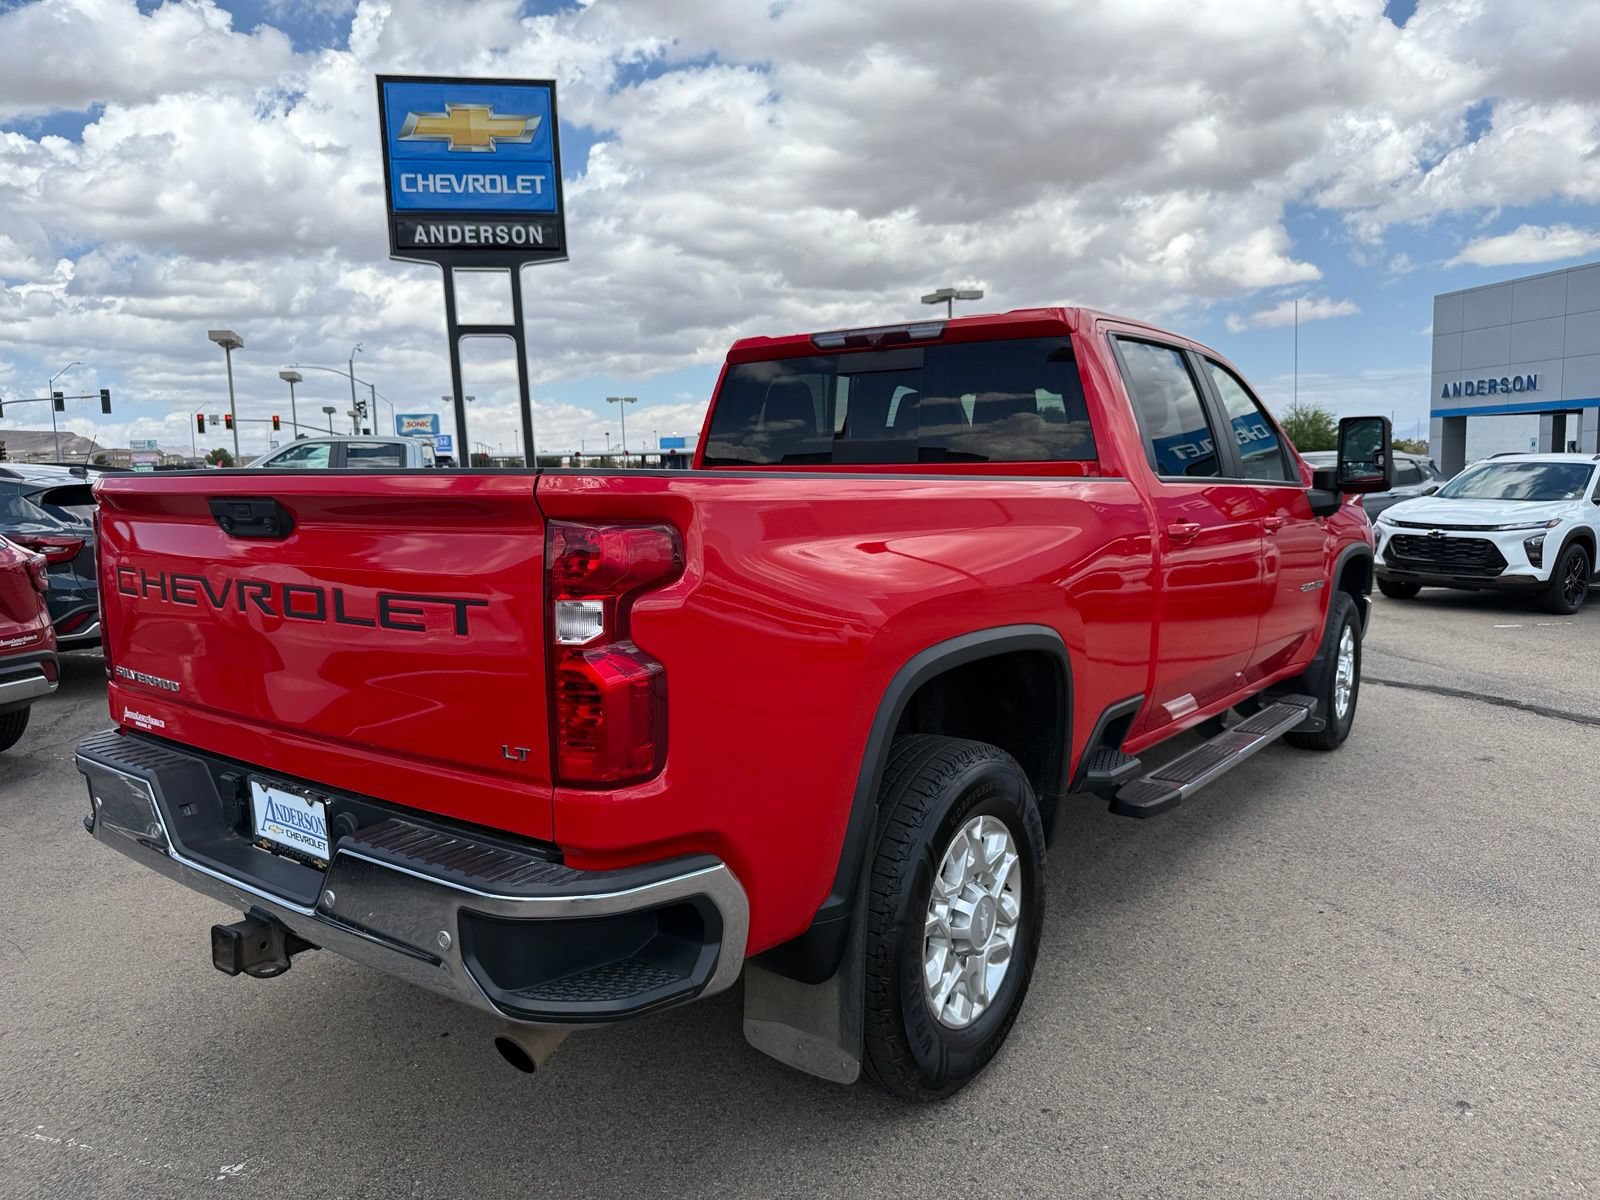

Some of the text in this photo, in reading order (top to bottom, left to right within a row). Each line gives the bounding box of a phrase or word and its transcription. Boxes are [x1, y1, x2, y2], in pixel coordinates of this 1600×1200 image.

[401, 173, 546, 194] CHEVROLET
[414, 225, 543, 244] ANDERSON
[1441, 374, 1538, 399] ANDERSON
[405, 420, 430, 428] SONIC
[116, 566, 489, 637] CHEVROLET
[116, 665, 180, 692] SILVERADO
[502, 744, 531, 762] LT
[286, 829, 327, 851] CHEVROLET
